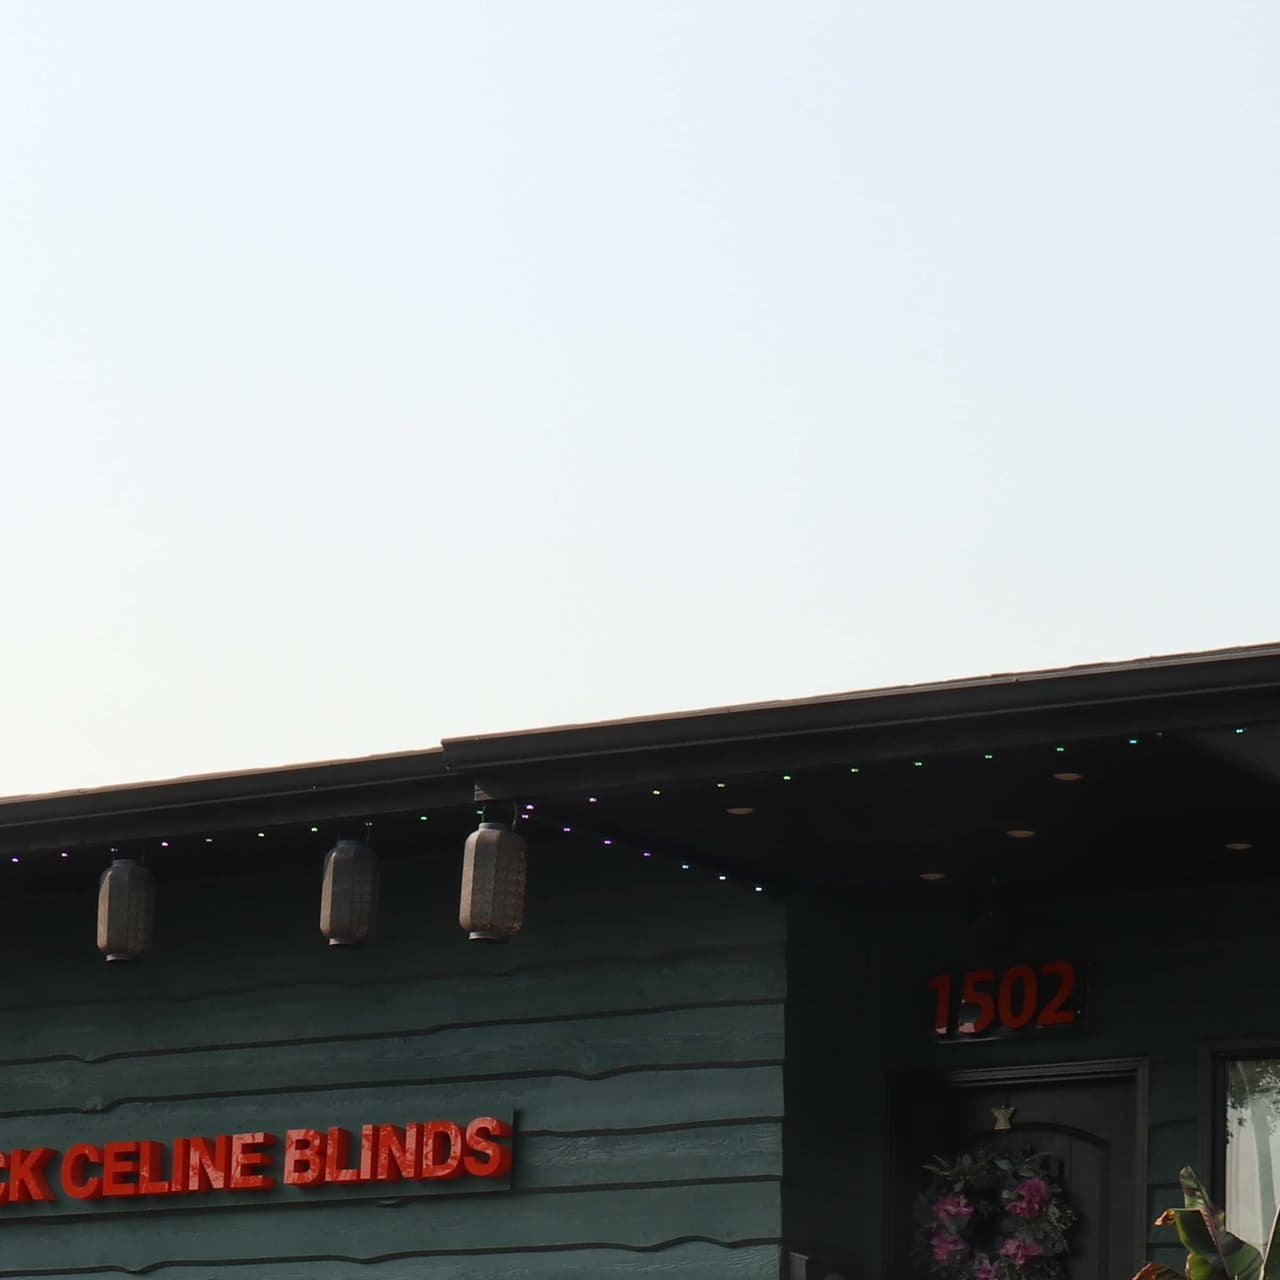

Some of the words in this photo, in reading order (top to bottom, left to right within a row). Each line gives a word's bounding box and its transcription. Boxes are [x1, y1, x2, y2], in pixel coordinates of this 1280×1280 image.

[928, 960, 1076, 1034] 1502
[60, 1132, 273, 1199] CELINE
[283, 1116, 513, 1188] BLINDS
